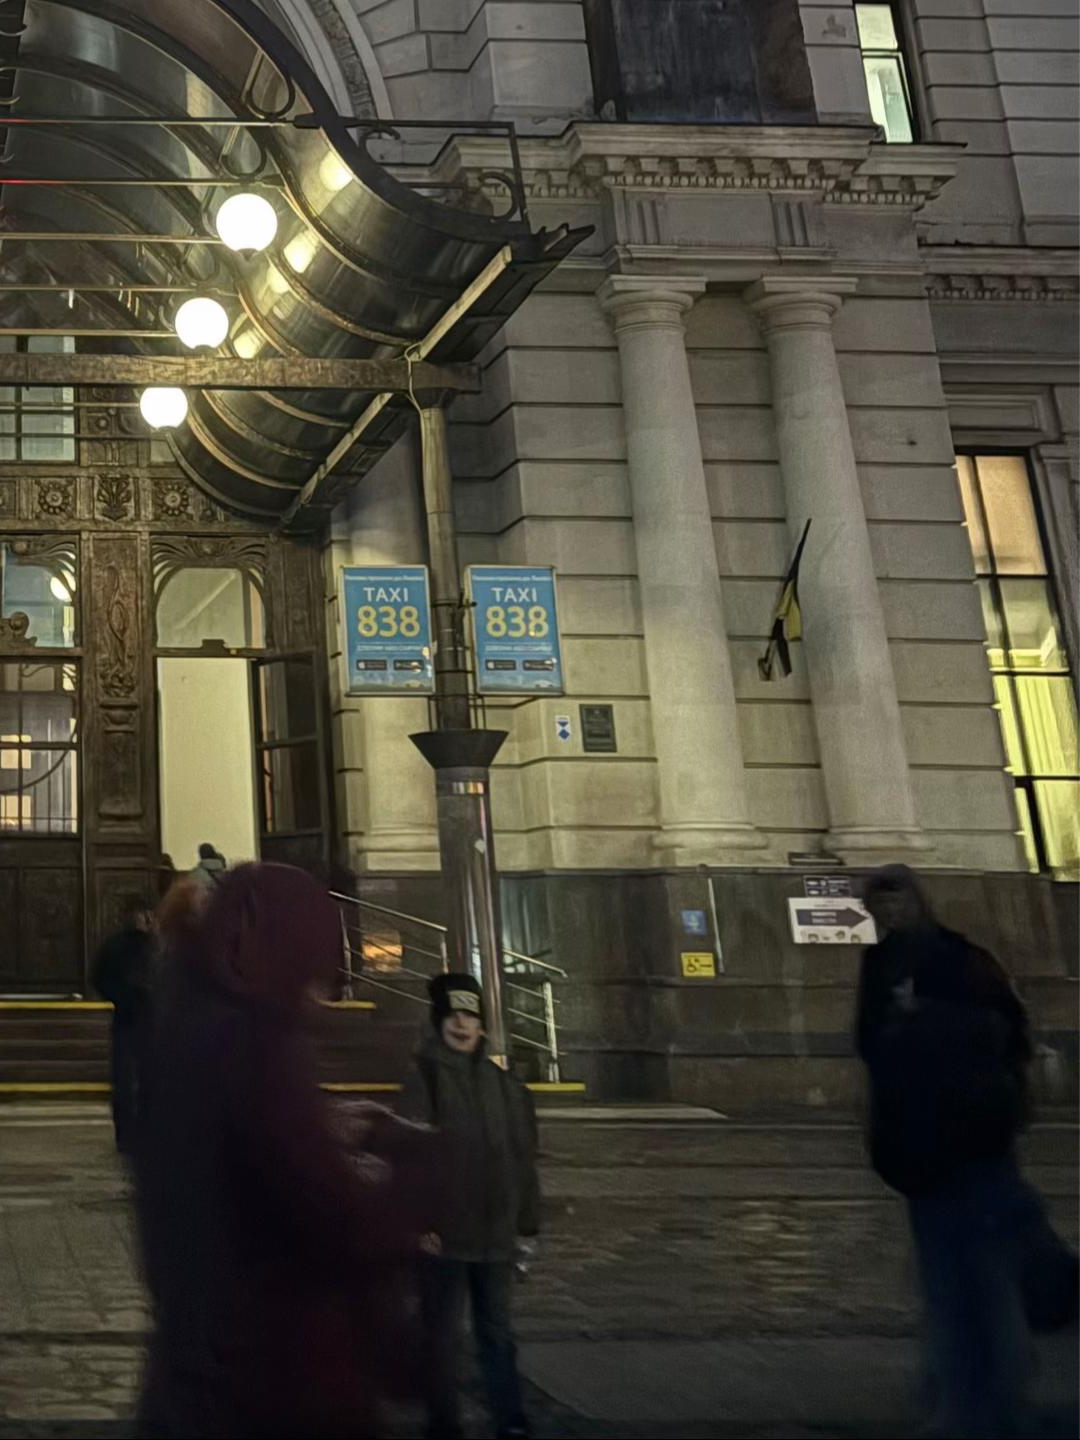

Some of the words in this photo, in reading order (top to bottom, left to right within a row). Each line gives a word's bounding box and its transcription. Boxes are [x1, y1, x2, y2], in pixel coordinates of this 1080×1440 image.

[363, 587, 409, 602] TAXI
[491, 587, 537, 602] TAXI
[357, 605, 420, 637] 838
[486, 605, 549, 638] 838
